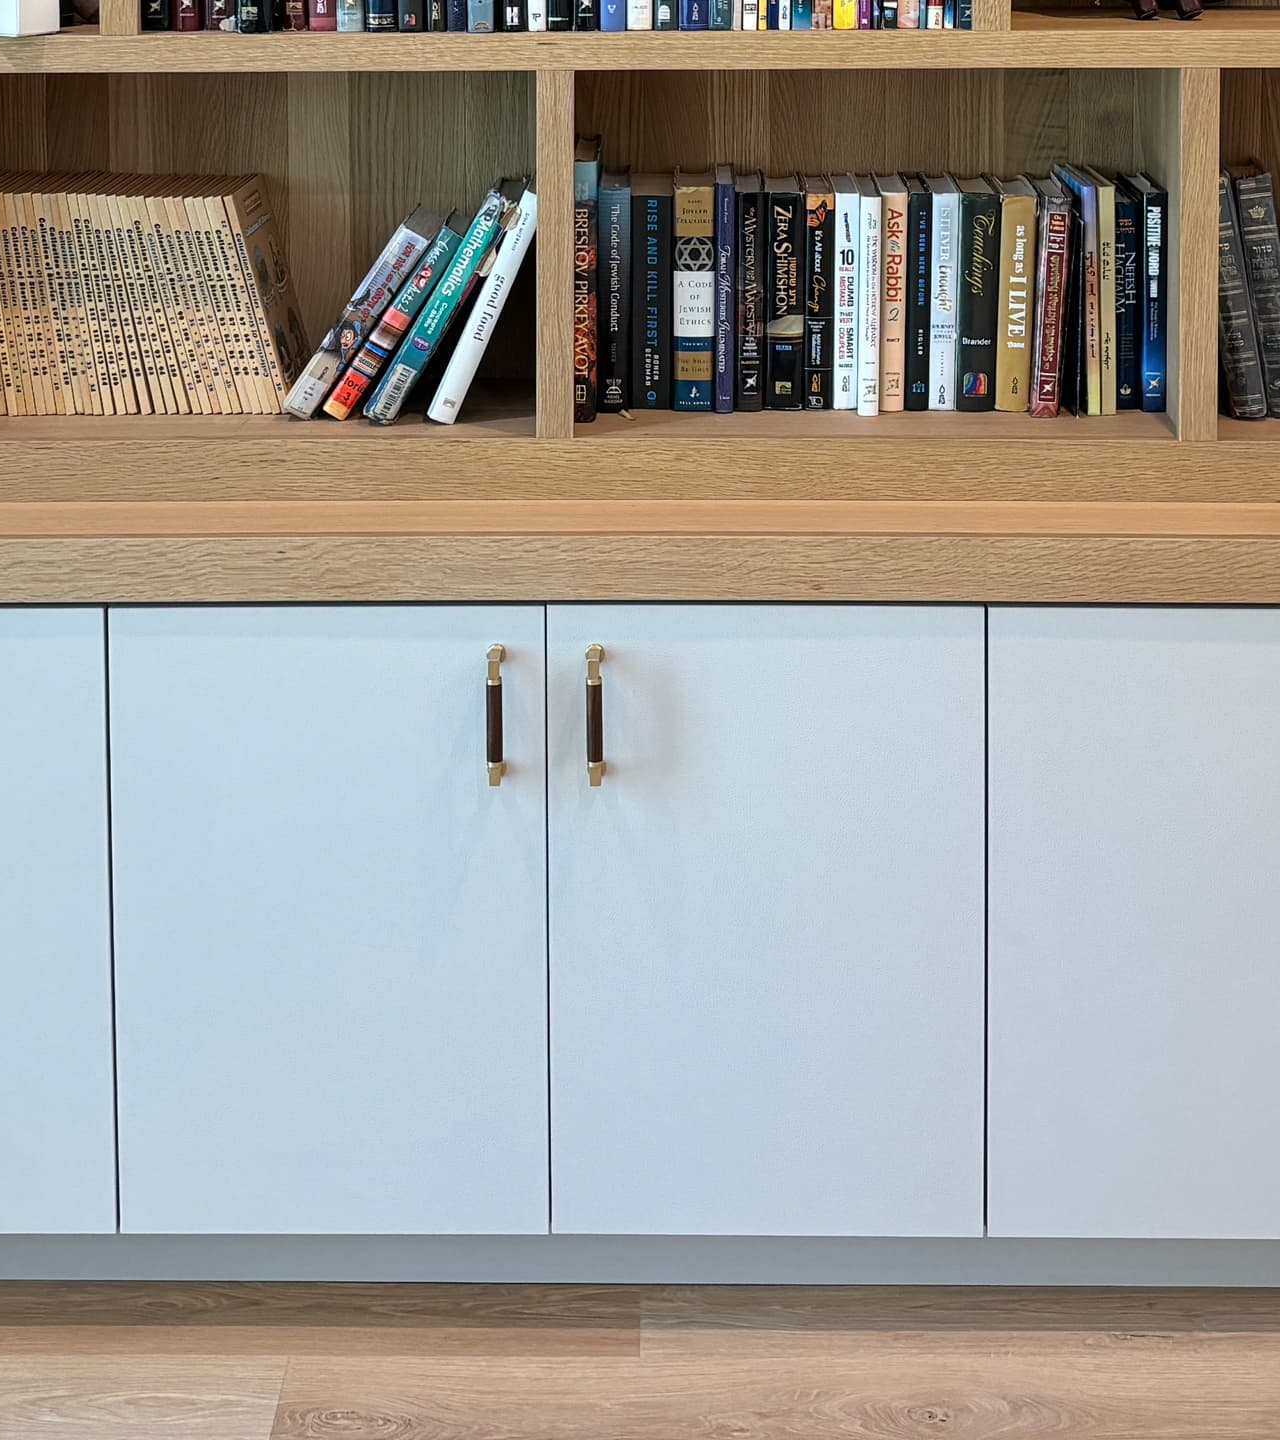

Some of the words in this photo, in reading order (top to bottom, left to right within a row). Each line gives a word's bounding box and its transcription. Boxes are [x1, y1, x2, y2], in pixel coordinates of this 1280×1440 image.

[611, 204, 620, 224] The
[648, 199, 658, 231] RISE
[774, 205, 792, 240] ZERA
[887, 208, 903, 239] Ask
[1147, 206, 1161, 247] POSITIVE
[574, 208, 588, 276] BRESLOV
[611, 225, 620, 248] Code
[940, 231, 950, 260] EVER
[1016, 225, 1025, 237] as
[611, 249, 619, 257] of
[648, 236, 658, 265] AND
[840, 249, 854, 266] 10
[965, 209, 995, 297] Teachings
[1009, 239, 1027, 261] long
[1148, 247, 1159, 276] WORD
[1252, 245, 1272, 254] סדור
[611, 258, 620, 291] Jewish
[774, 242, 792, 315] SHIMSHON
[788, 257, 796, 286] שמשון
[886, 254, 902, 303] Rabbi
[1009, 276, 1027, 284] I
[1014, 263, 1025, 274] as
[1125, 252, 1136, 304] NEFESH
[489, 273, 506, 310] good
[648, 271, 658, 302] KILL
[688, 280, 713, 288] CODE
[934, 265, 952, 312] Enough?
[574, 280, 588, 331] PIRKEY
[611, 293, 620, 332] Conduct
[679, 305, 711, 313] JEWISH
[888, 307, 899, 322] 2
[473, 311, 494, 342] food
[648, 308, 658, 346] FIRST
[679, 318, 712, 326] ETHICS
[574, 332, 589, 379] AVOT
[962, 337, 992, 346] Brander
